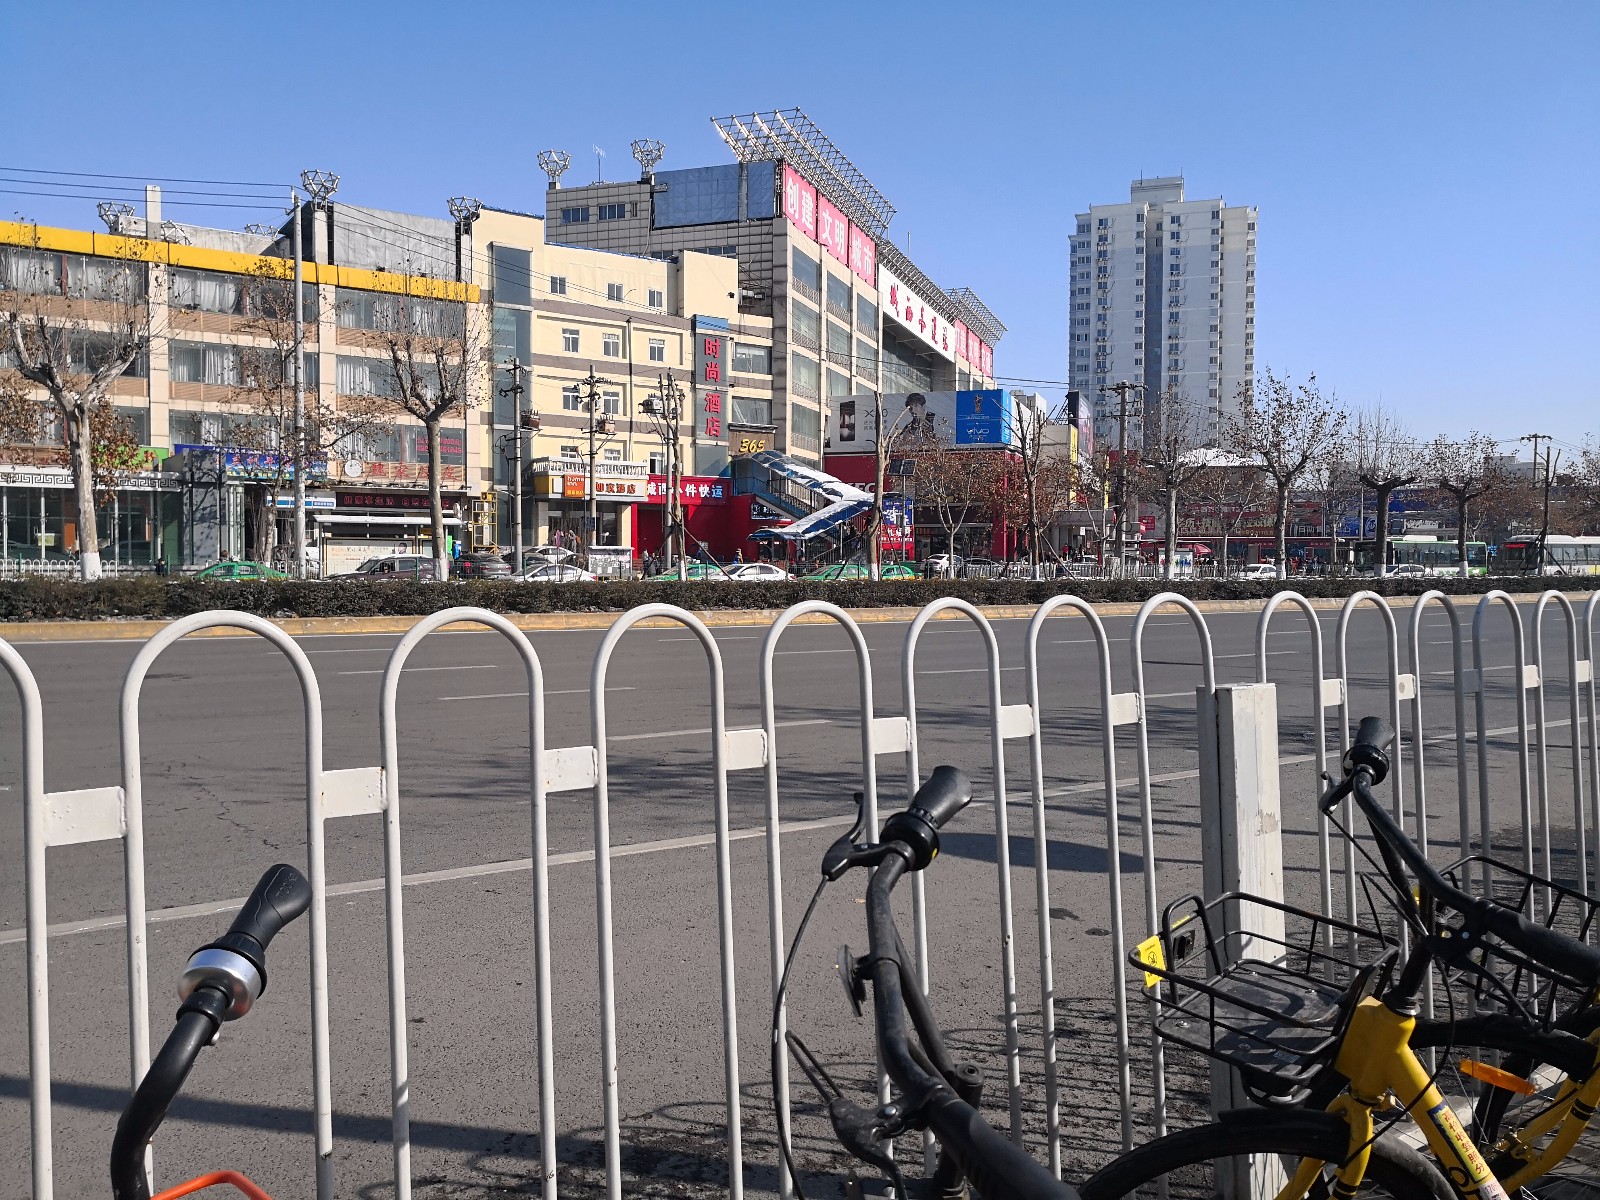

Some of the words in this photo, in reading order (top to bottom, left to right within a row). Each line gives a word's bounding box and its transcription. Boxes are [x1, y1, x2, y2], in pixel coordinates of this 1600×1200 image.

[786, 176, 873, 277] 创建文明城市
[704, 338, 721, 437] 时尚酒店
[864, 409, 889, 418] X0
[739, 438, 765, 453] 365
